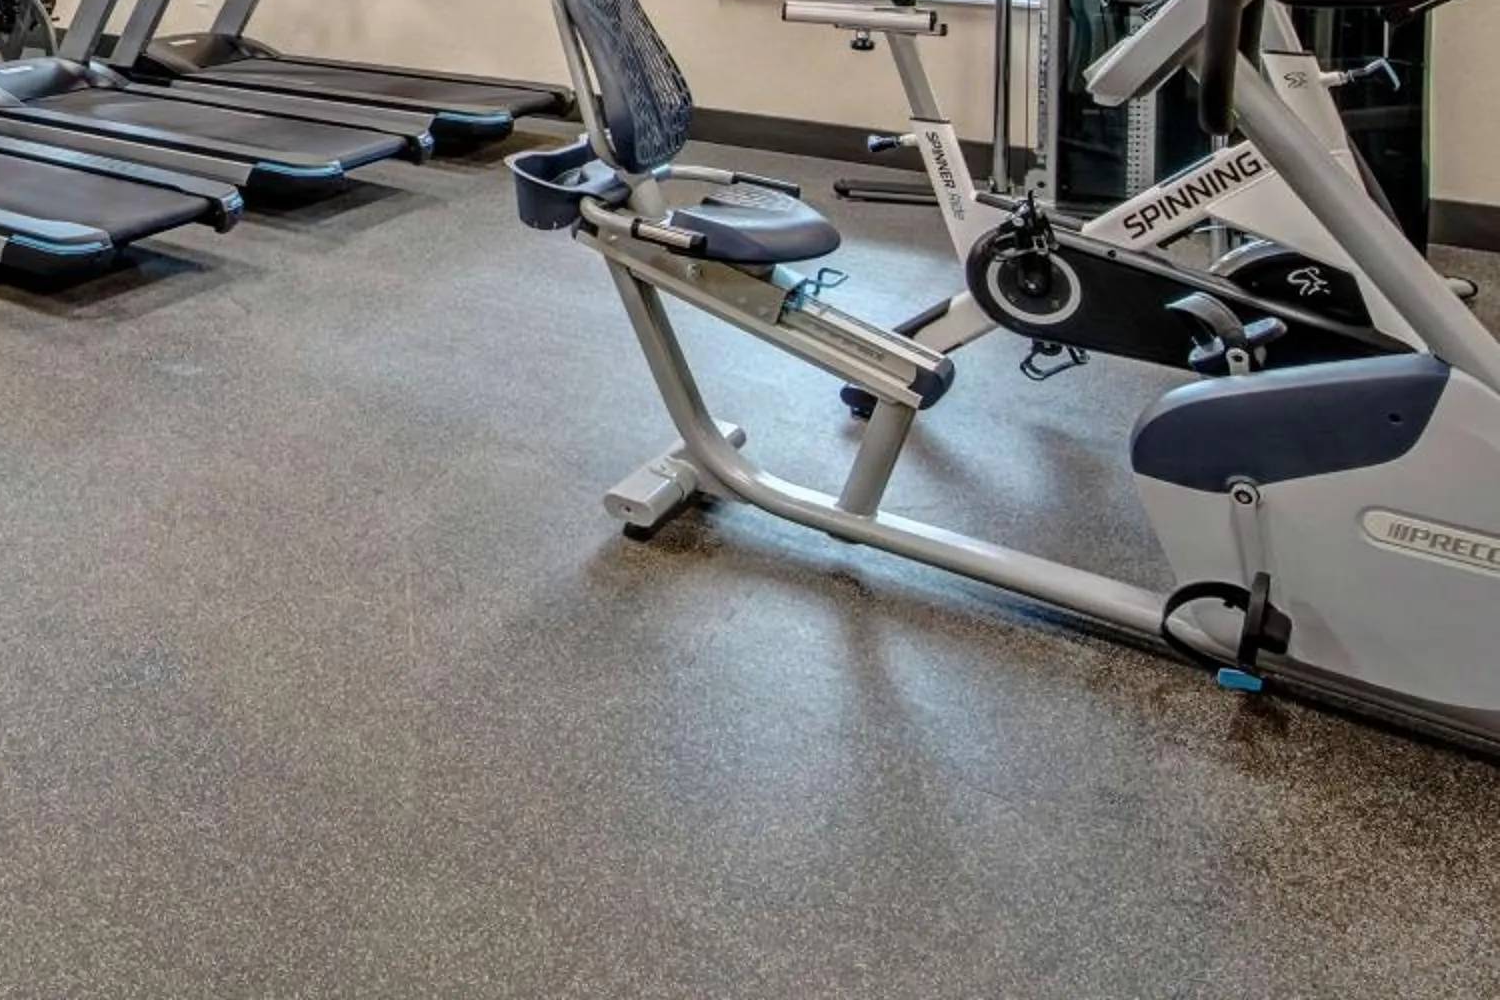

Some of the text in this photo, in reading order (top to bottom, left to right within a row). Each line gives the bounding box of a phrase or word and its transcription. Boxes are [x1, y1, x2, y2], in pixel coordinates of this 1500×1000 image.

[925, 131, 956, 188] SPINNER
[1123, 151, 1263, 240] SPINNING
[1408, 527, 1500, 566] PRECO
